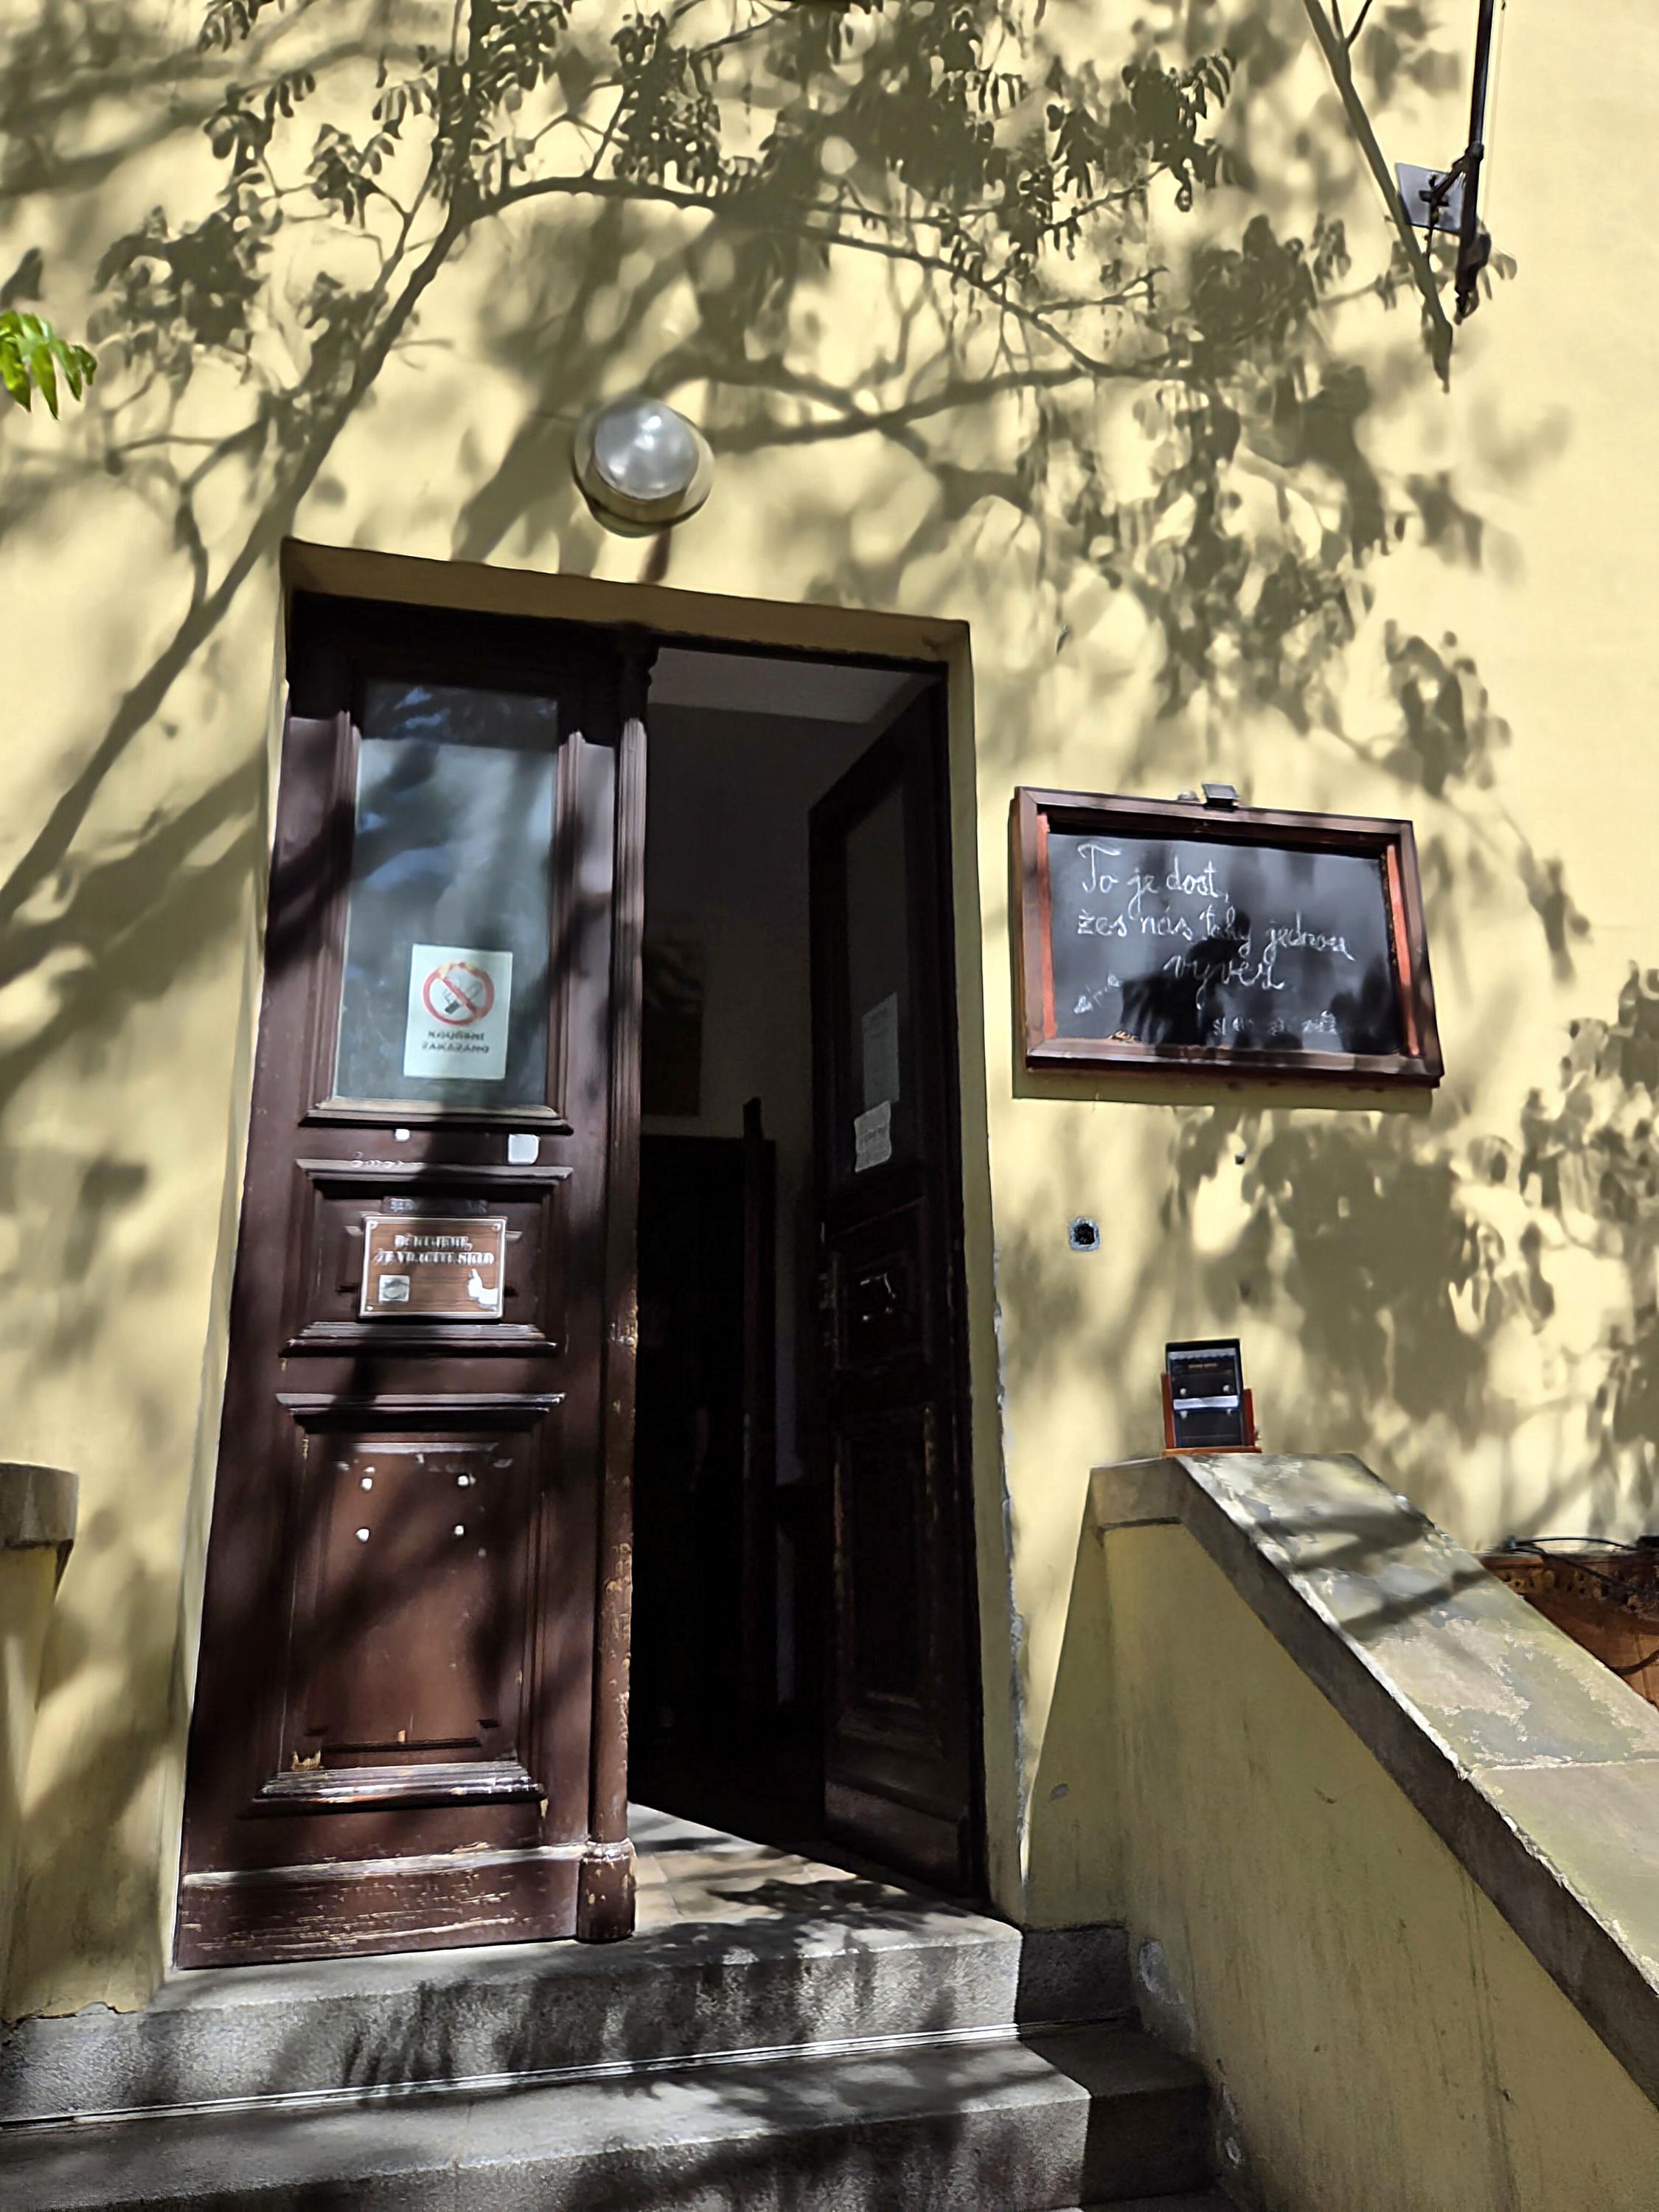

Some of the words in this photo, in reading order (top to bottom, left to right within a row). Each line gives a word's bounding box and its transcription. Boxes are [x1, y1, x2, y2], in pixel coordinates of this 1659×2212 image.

[1077, 844, 1121, 894] To
[1127, 867, 1158, 920] je
[1166, 855, 1228, 903] dost,
[1140, 905, 1193, 941] nás
